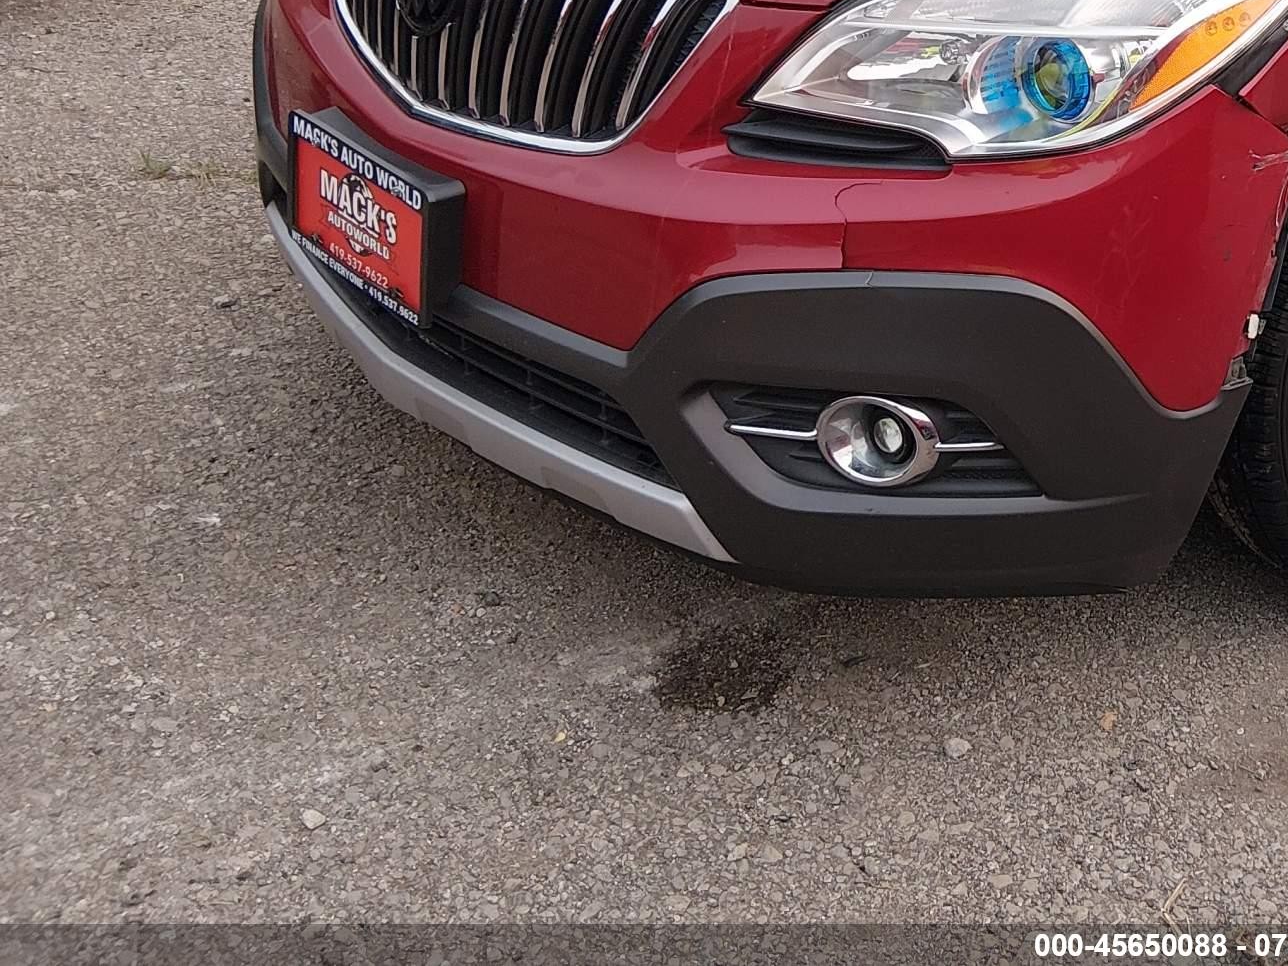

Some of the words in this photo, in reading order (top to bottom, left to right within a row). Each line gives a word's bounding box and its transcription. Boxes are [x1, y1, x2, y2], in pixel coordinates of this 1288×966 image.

[293, 115, 339, 158] MACK'S
[340, 145, 374, 180] AUTO
[376, 166, 422, 210] WORLD
[320, 169, 397, 244] MACK'S
[327, 210, 391, 260] AUTOWORLD
[291, 229, 303, 244] WE
[302, 236, 330, 265] FINANCE
[328, 256, 365, 291] EVERYONE
